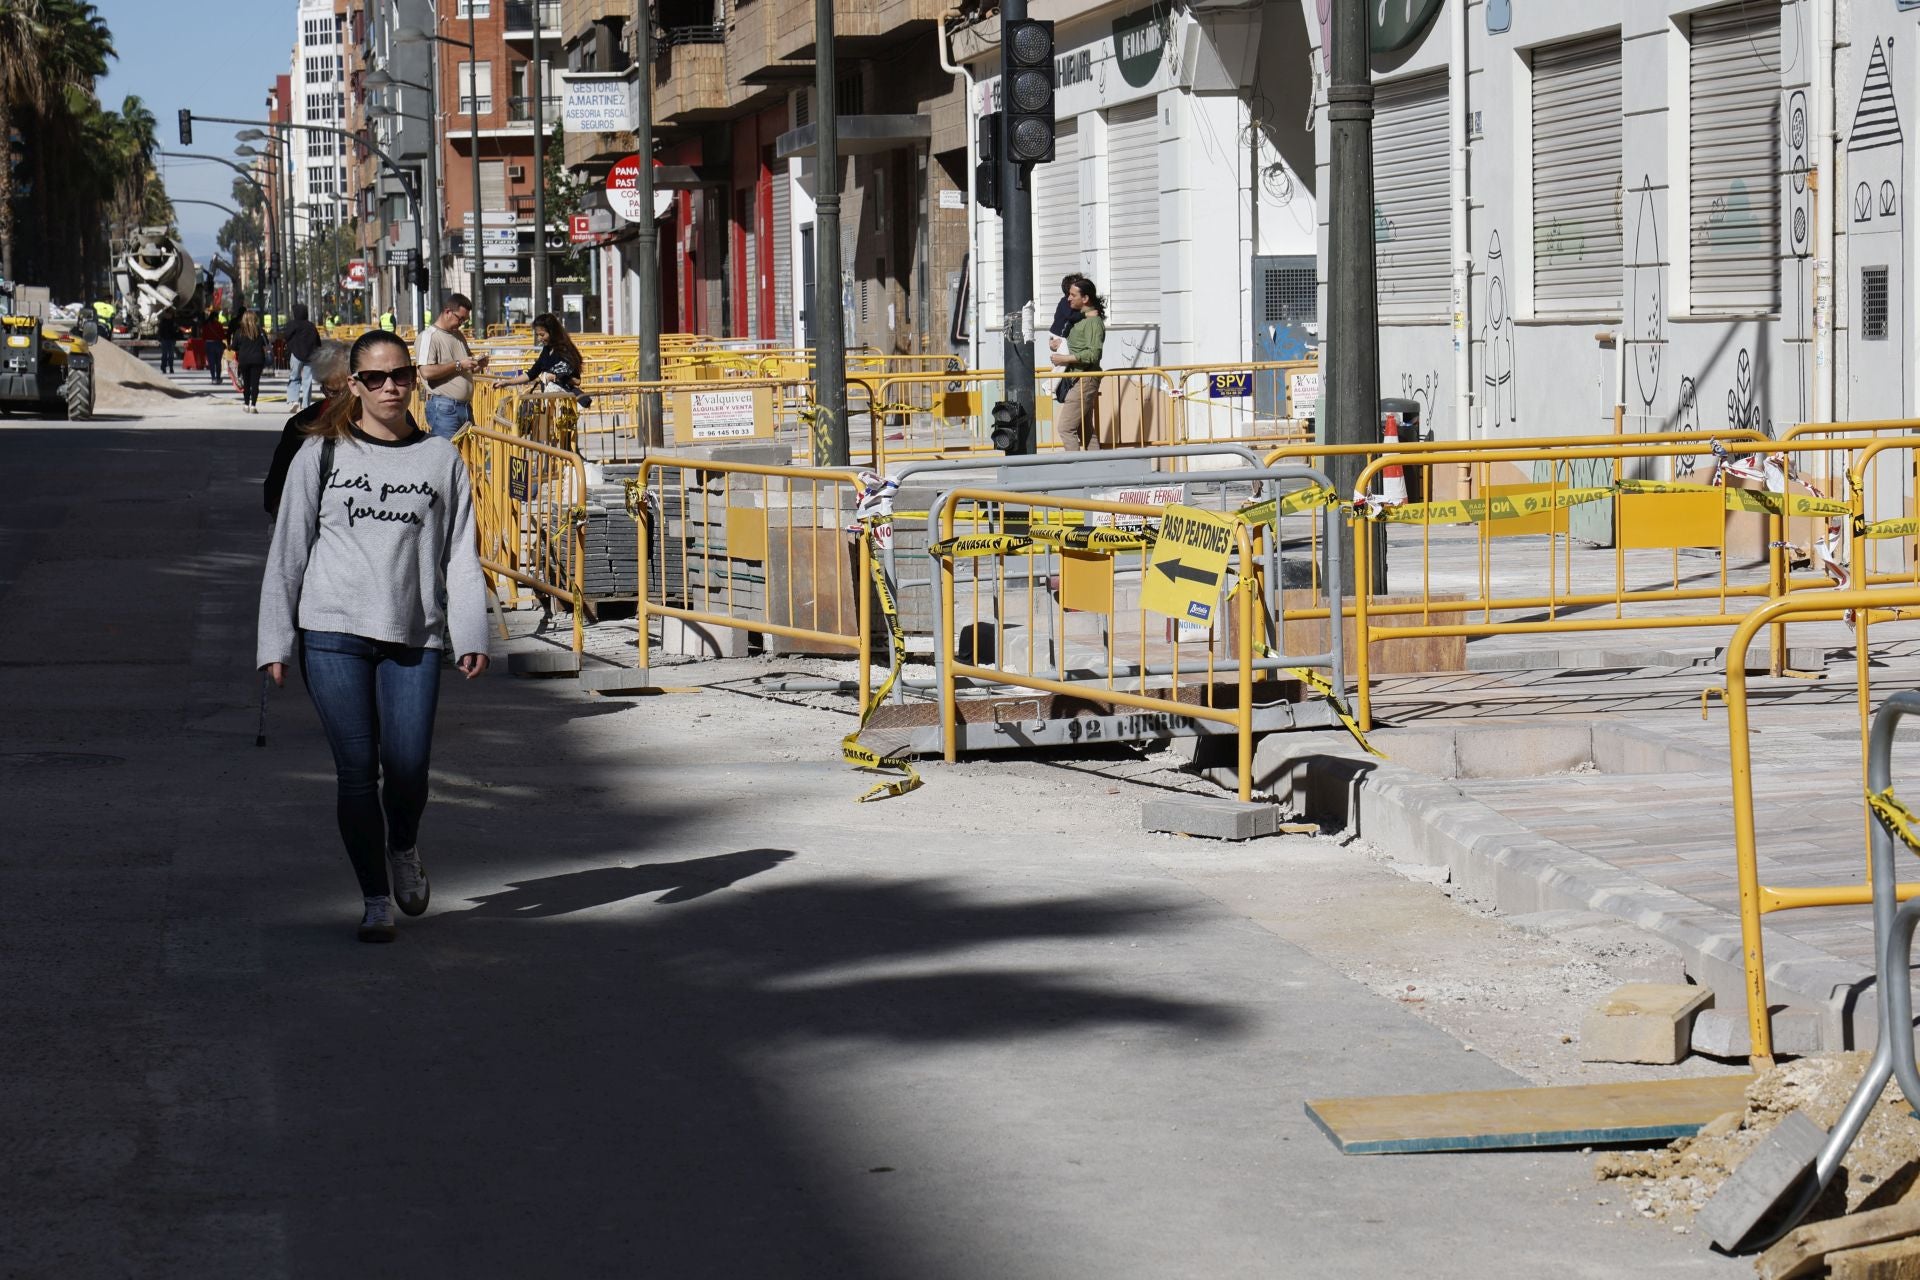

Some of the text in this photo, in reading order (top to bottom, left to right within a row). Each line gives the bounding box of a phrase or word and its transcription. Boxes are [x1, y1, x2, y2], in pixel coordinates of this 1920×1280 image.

[573, 82, 619, 93] GESTORIA
[568, 95, 624, 106] A.MARTINEZ
[566, 108, 629, 119] ASESORIA FISCAL
[580, 119, 615, 129] SEGUROS
[615, 167, 639, 176] PANA
[615, 178, 636, 188] PAST
[509, 275, 532, 284] SILLONE
[1216, 375, 1246, 388] SPV
[704, 393, 752, 406] valquiven
[512, 458, 527, 482] SPV
[328, 468, 440, 509] Let's party
[343, 496, 421, 528] forever
[879, 527, 892, 538] NO
[1162, 514, 1184, 543] PASO
[1182, 519, 1231, 554] PEATONES
[956, 538, 991, 552] PAVASAL
